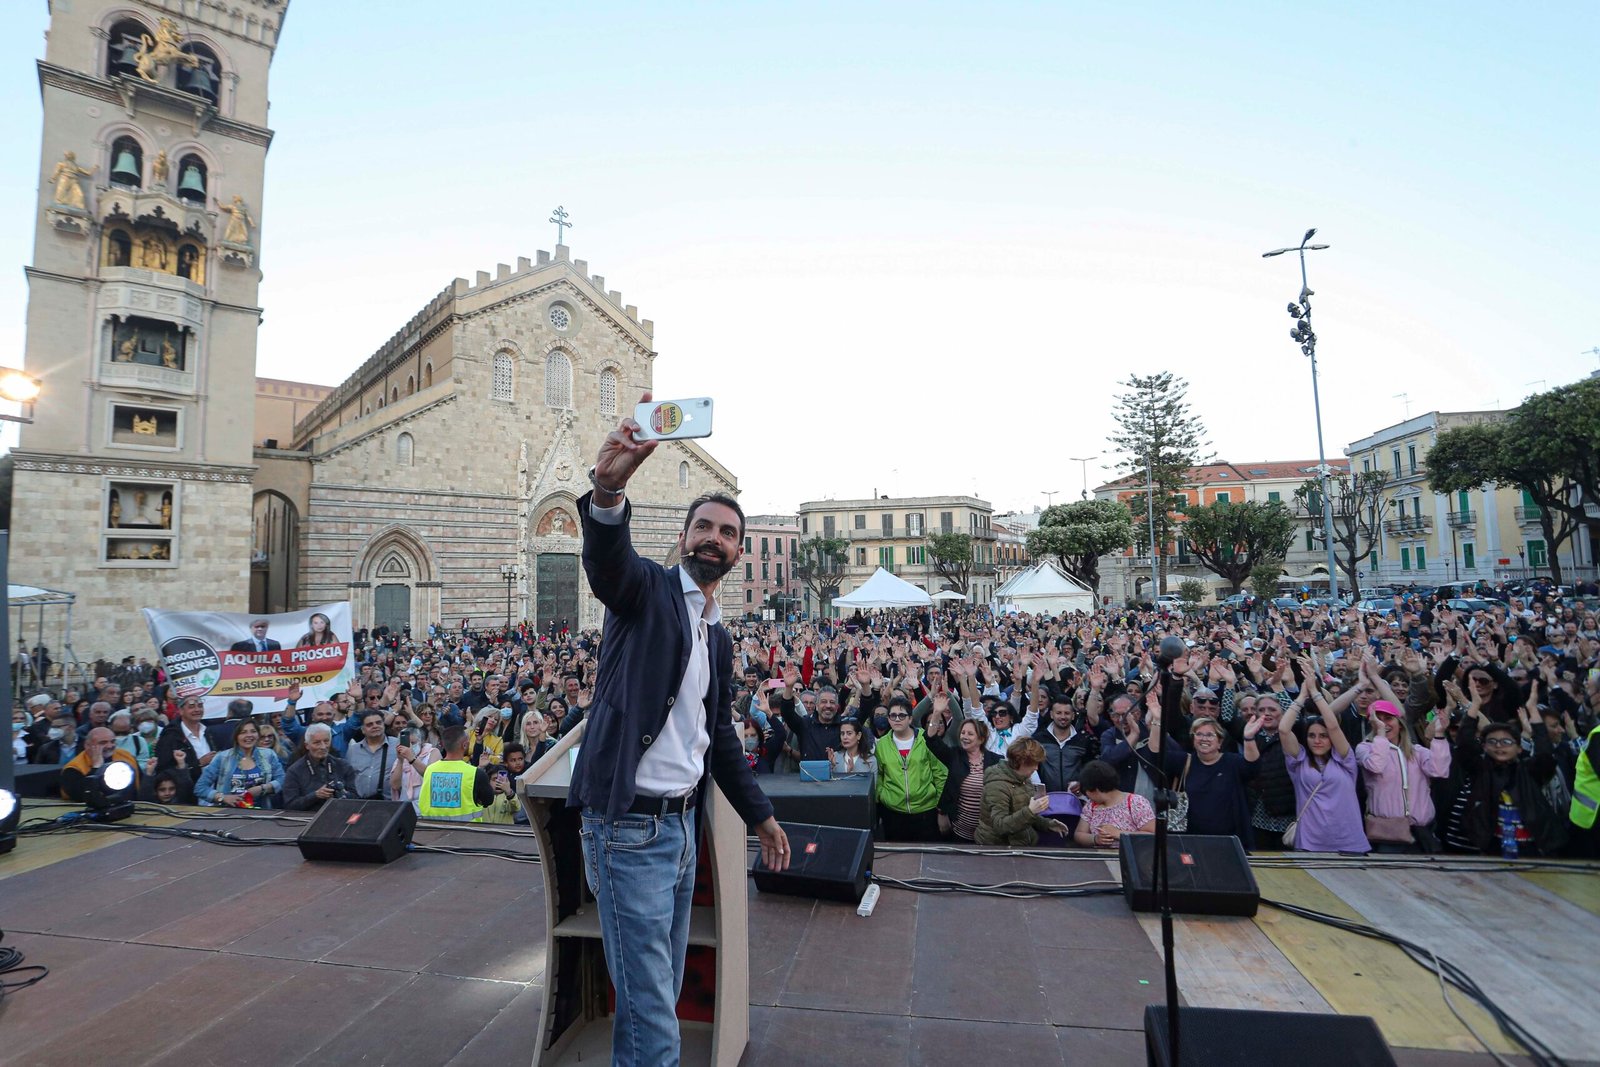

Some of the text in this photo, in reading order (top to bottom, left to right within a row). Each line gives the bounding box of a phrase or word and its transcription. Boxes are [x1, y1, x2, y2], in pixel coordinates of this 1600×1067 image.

[224, 645, 343, 666] AQUILA PROSCIA
[167, 656, 218, 675] ESSINESE
[255, 664, 307, 675] FAN CLUB
[235, 679, 274, 691] BASILE
[275, 674, 323, 687] SINDACO
[431, 790, 460, 803] 0104
